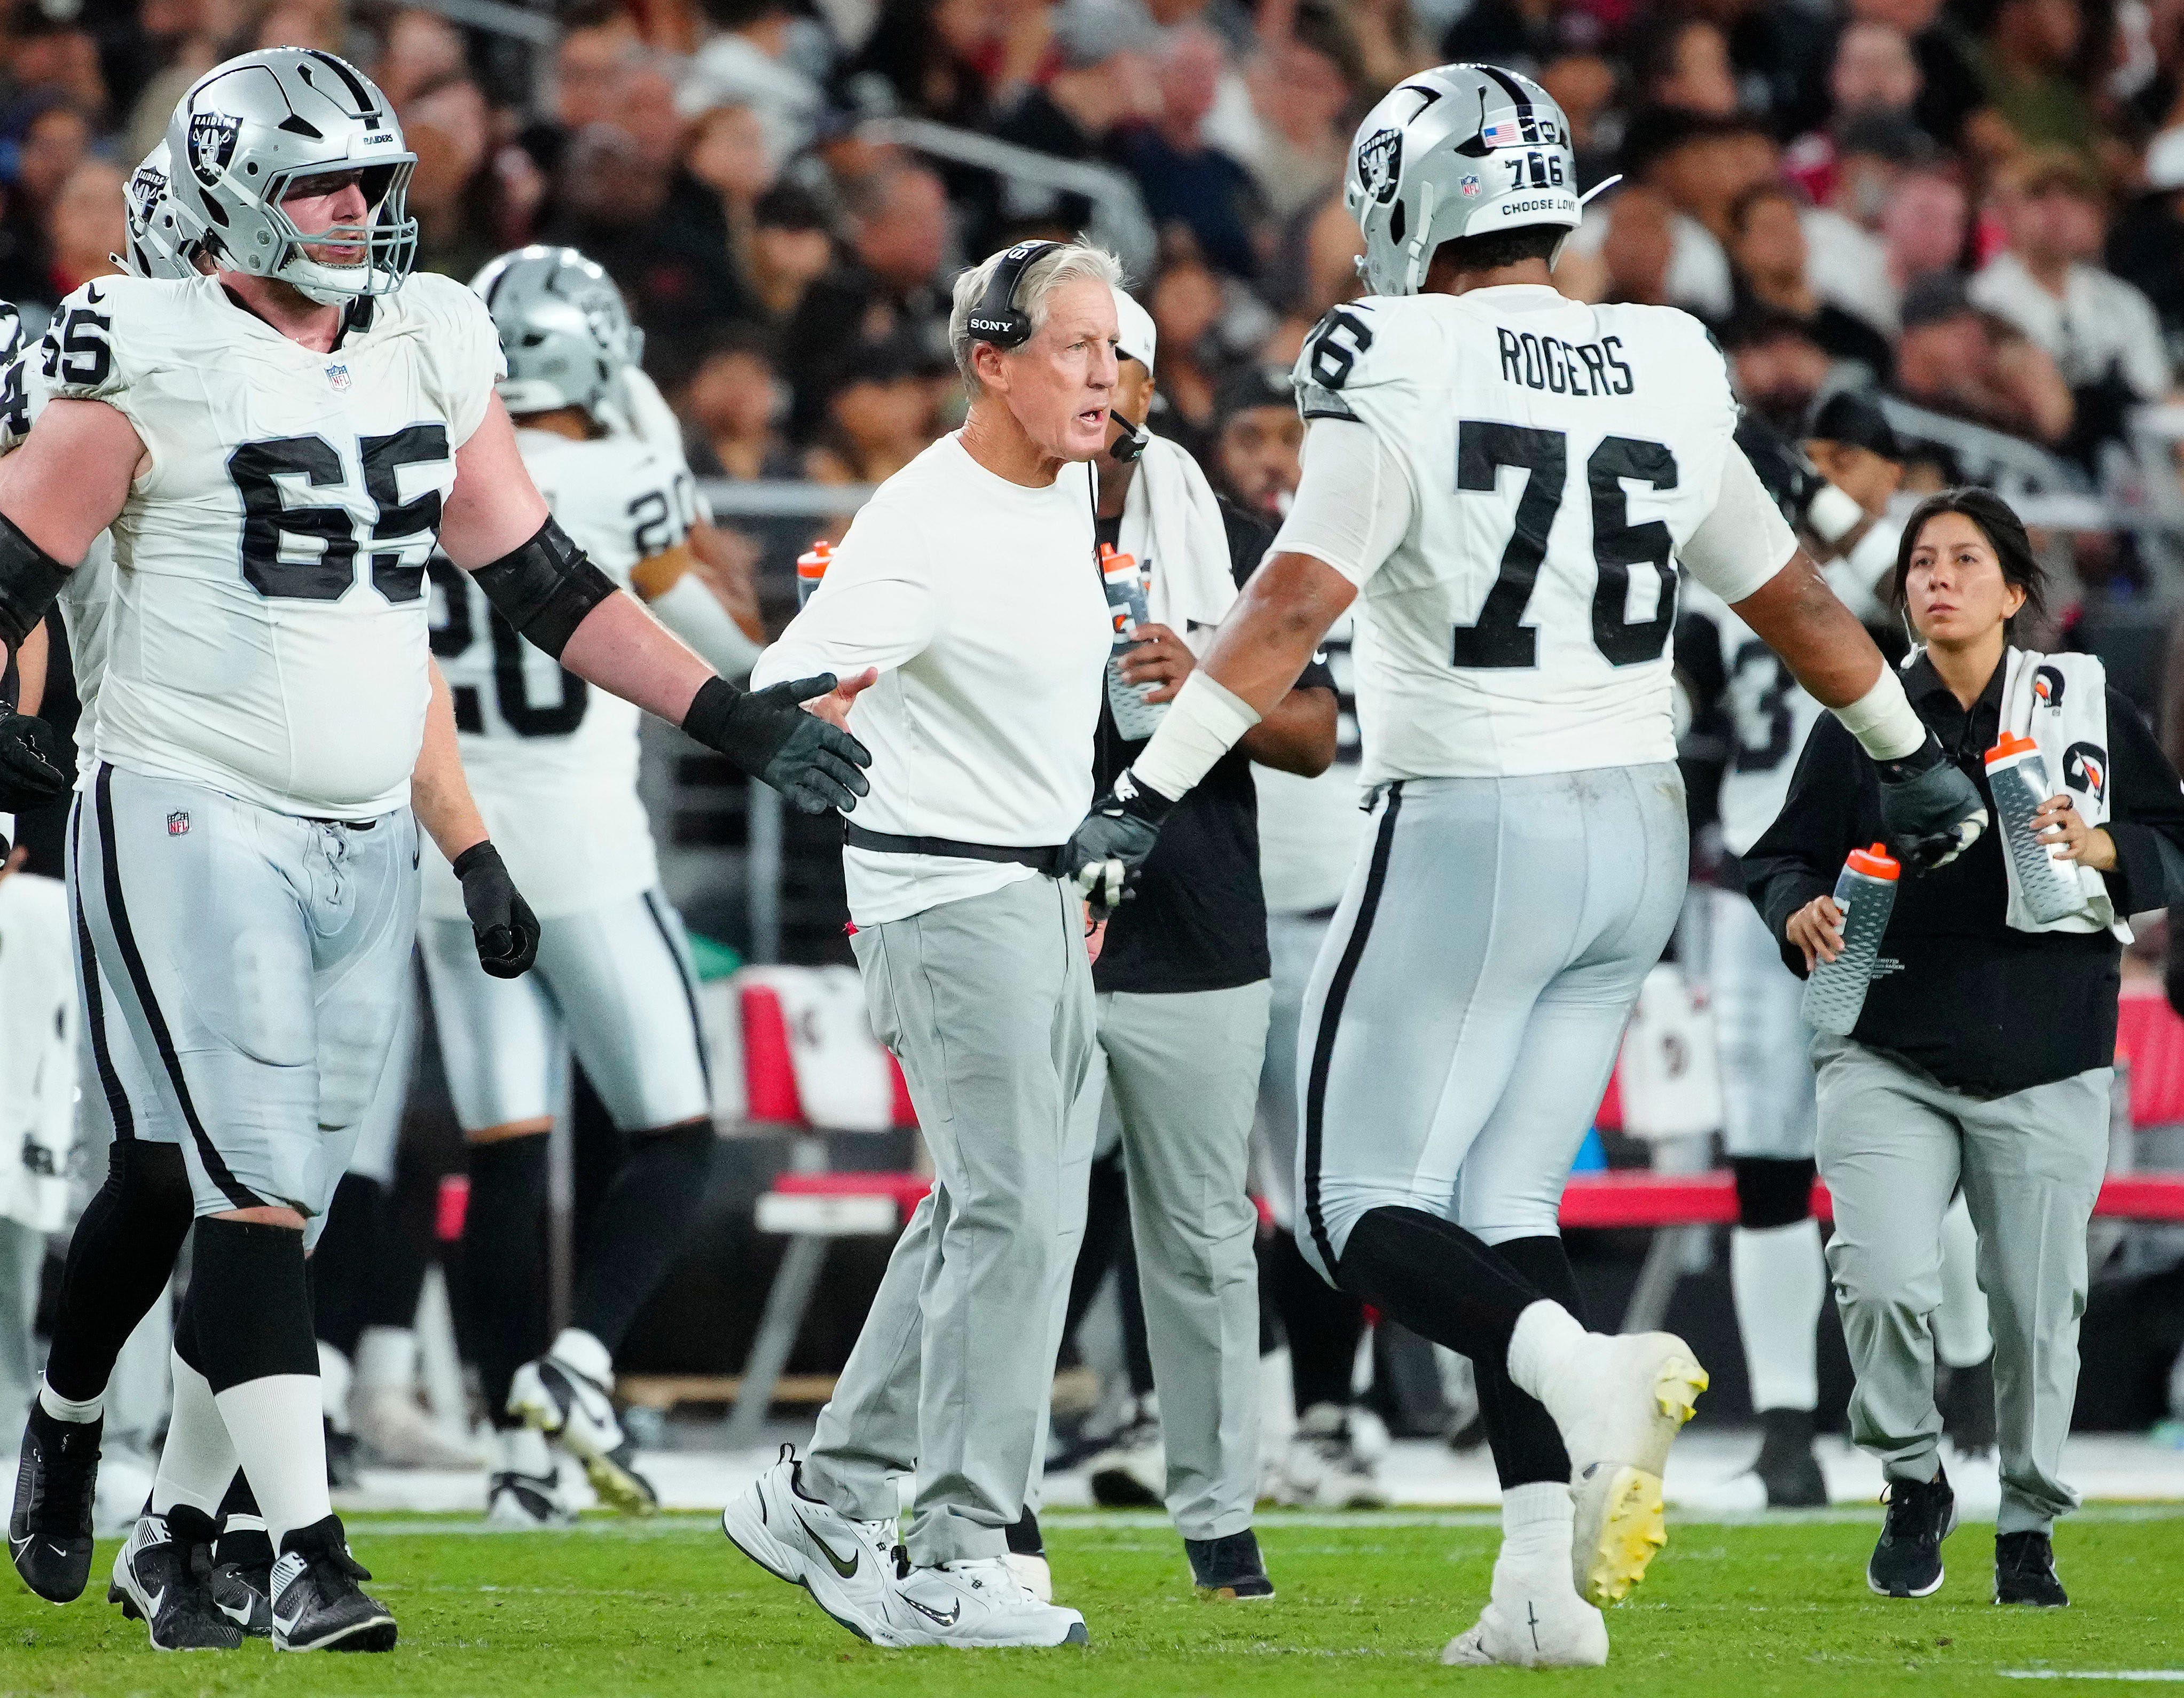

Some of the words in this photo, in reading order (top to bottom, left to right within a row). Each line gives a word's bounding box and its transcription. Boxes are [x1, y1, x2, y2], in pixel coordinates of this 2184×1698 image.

[363, 134, 394, 145] RAIDERS
[1464, 184, 1479, 195] NFL
[1502, 199, 1553, 215] CHOOSE
[970, 318, 1013, 332] SONY
[1305, 307, 1373, 389] 6
[1496, 325, 1634, 396] ROGERS
[332, 374, 349, 386] NFL
[225, 421, 451, 606] 65
[1450, 418, 1679, 670] 76
[169, 821, 187, 833] NFL
